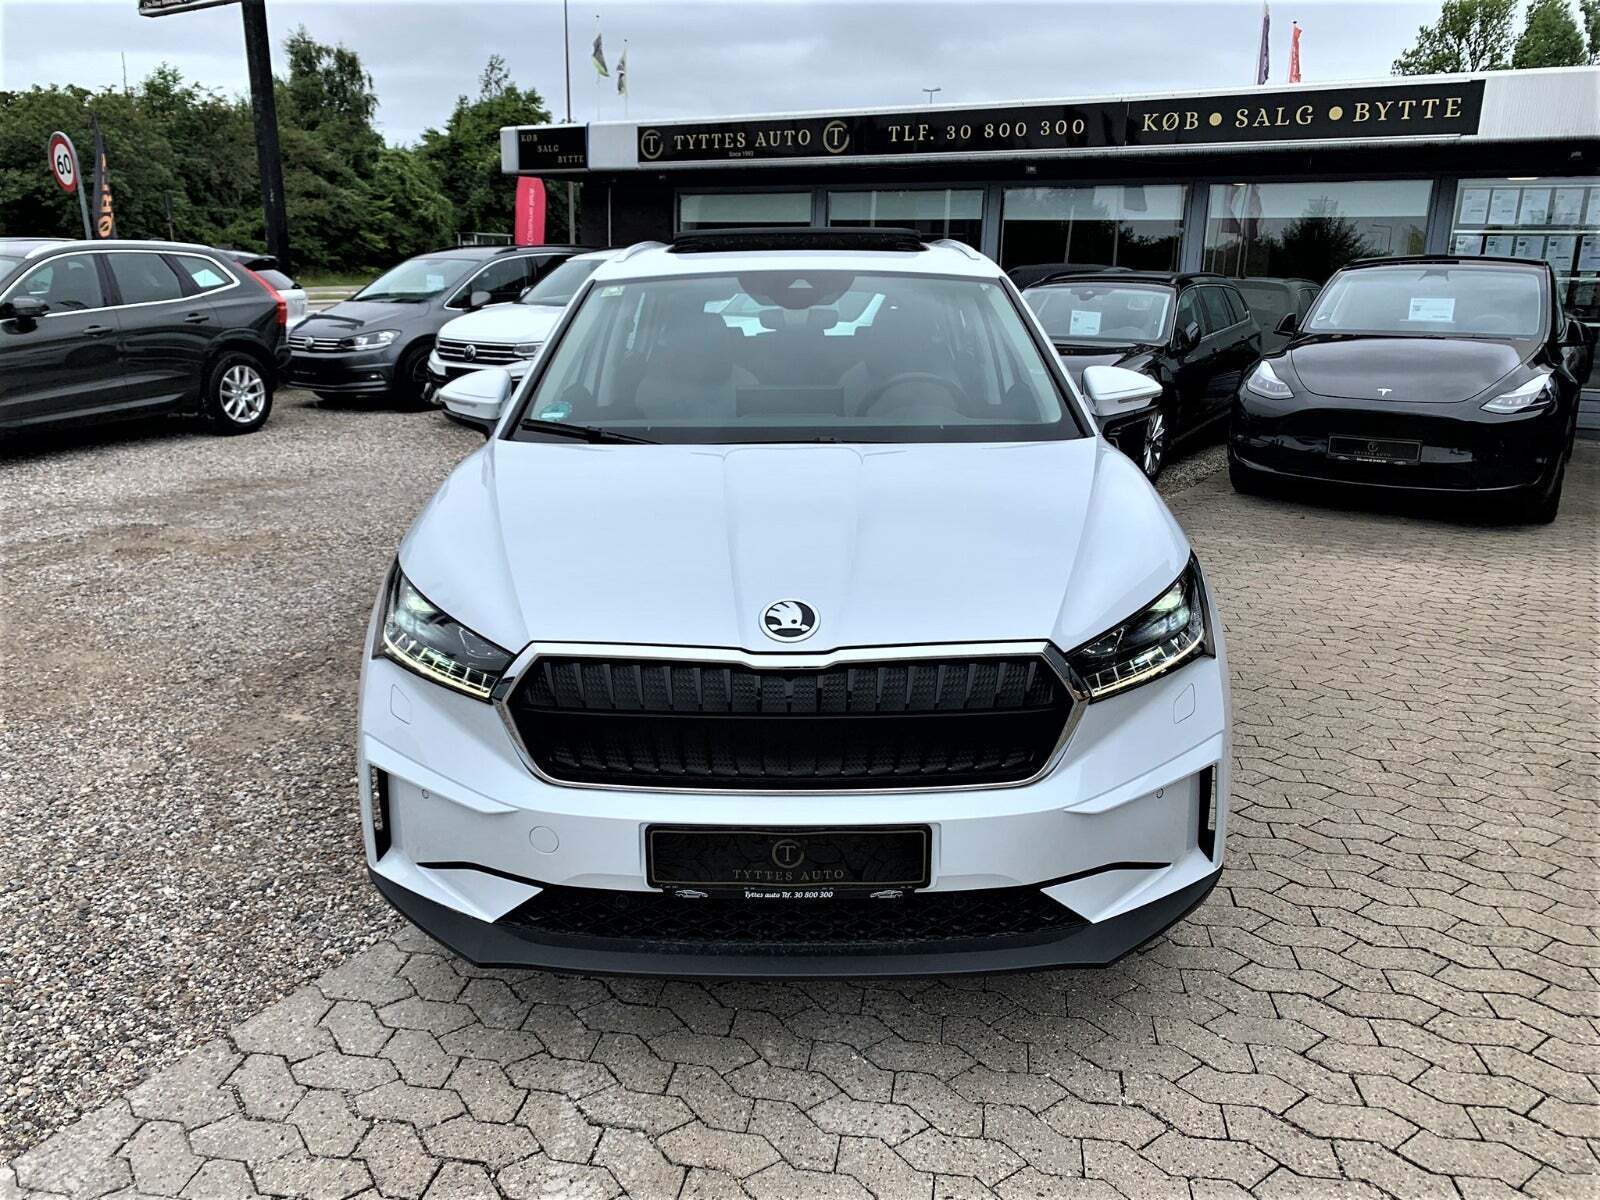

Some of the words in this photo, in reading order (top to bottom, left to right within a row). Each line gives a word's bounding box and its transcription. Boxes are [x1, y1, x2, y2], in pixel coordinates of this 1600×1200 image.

[1142, 111, 1199, 132] KØB
[1235, 105, 1315, 128] SALG
[1353, 98, 1463, 123] BYTTE
[673, 132, 746, 150] TYTTES
[755, 129, 811, 147] AUTO
[888, 124, 935, 142] TLF.
[946, 125, 971, 140] 30
[984, 122, 1027, 138] 800
[1040, 119, 1085, 136] 300
[537, 144, 559, 153] SALG
[57, 154, 71, 175] 60
[732, 869, 793, 881] TYTTES
[800, 869, 844, 881] AUTO
[744, 891, 763, 899] Tyttes
